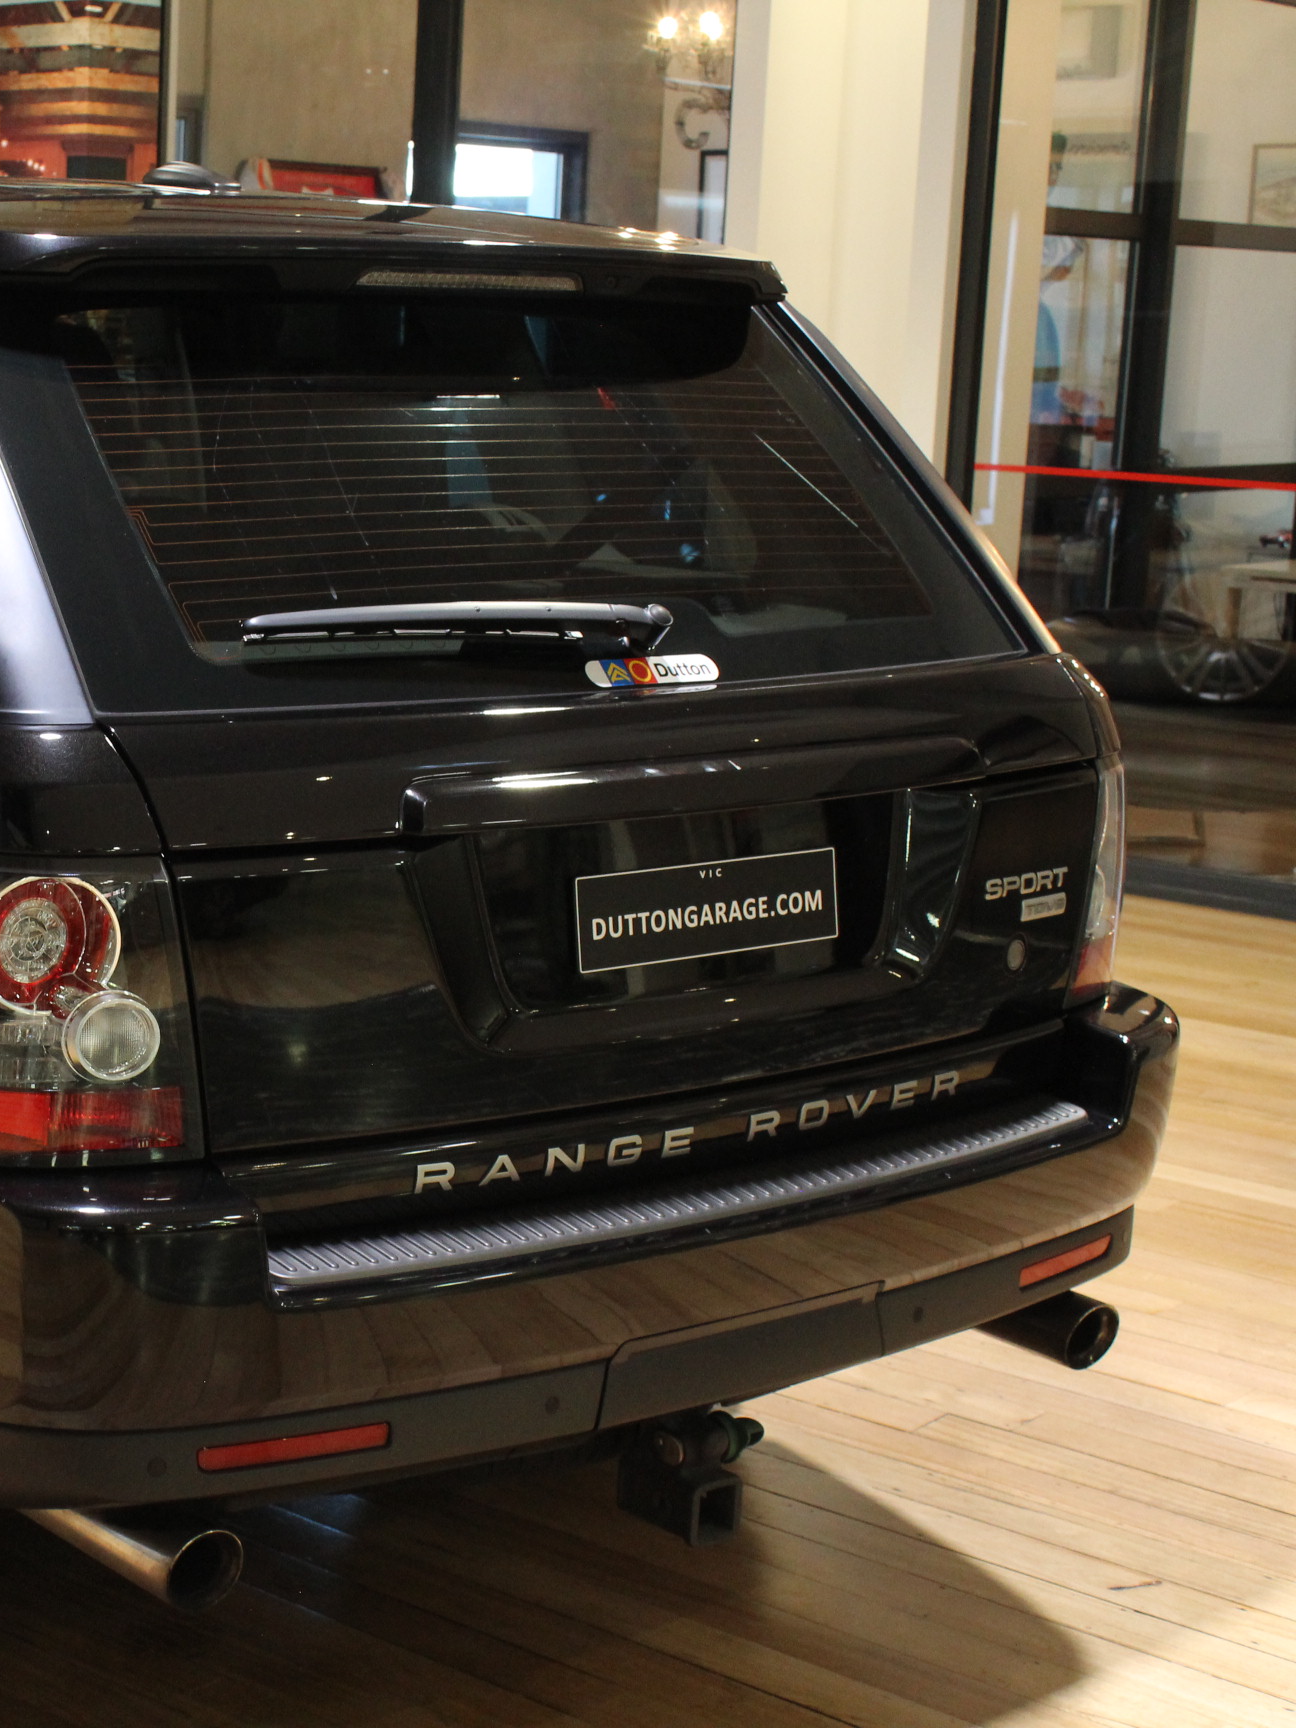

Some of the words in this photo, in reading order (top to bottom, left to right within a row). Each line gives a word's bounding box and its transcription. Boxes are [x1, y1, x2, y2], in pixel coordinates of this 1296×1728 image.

[654, 662, 711, 677] Dutton
[699, 868, 722, 879] VIC
[985, 866, 1068, 900] SPORT
[592, 889, 823, 941] DUTTONGARAGE.COM
[414, 1127, 694, 1194] RANGE
[747, 1070, 960, 1141] ROVER
